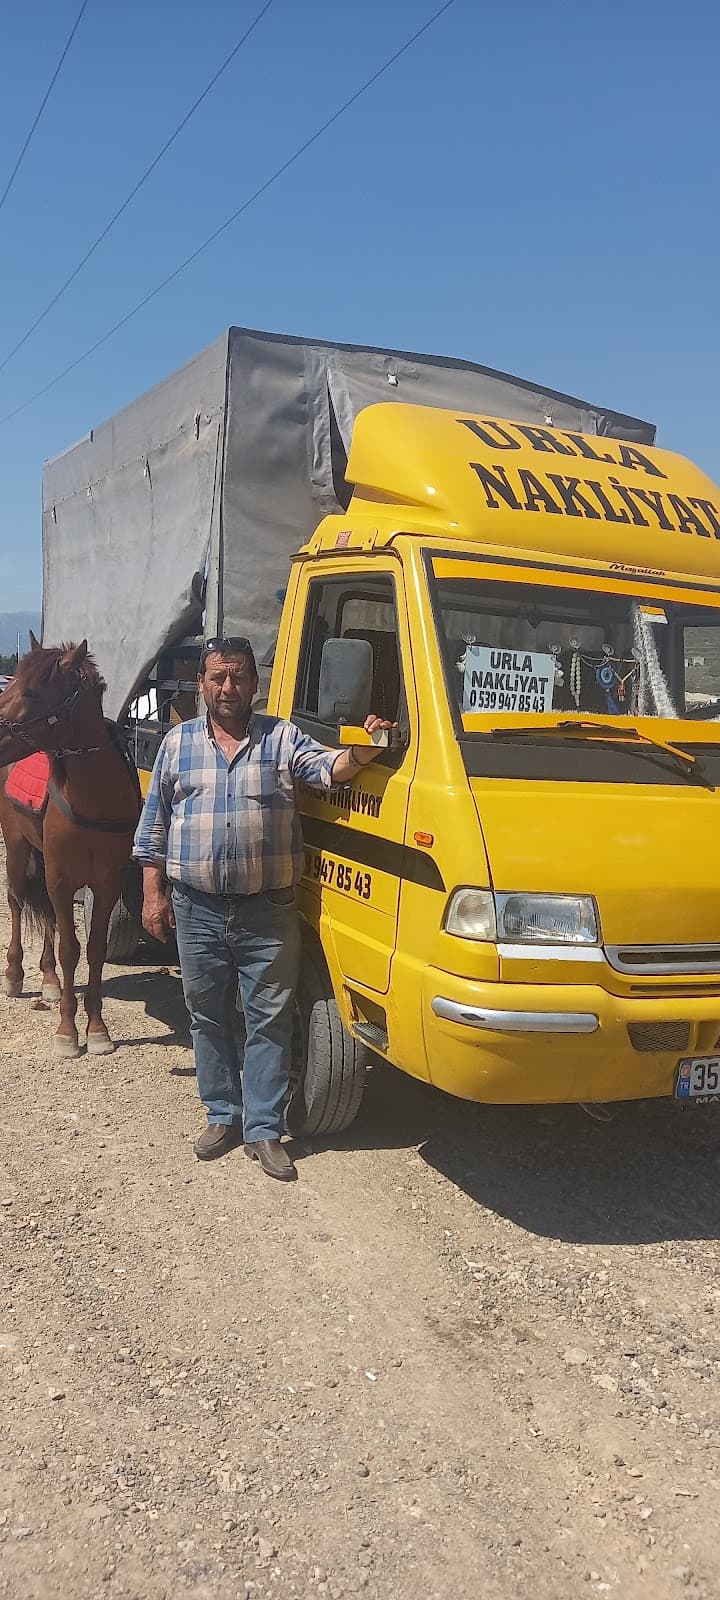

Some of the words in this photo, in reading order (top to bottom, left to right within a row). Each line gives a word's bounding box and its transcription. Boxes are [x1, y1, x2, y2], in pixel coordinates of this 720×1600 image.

[456, 419, 669, 479] URLA
[490, 651, 533, 673] URLA
[469, 689, 477, 707] 0
[478, 690, 497, 709] 539
[498, 692, 517, 711] 947
[518, 694, 531, 712] 85
[532, 696, 545, 713] 43
[314, 855, 336, 884] 947
[336, 863, 352, 892] 85
[354, 870, 372, 900] 43
[680, 1081, 690, 1091] TR
[693, 1062, 719, 1091] 35
